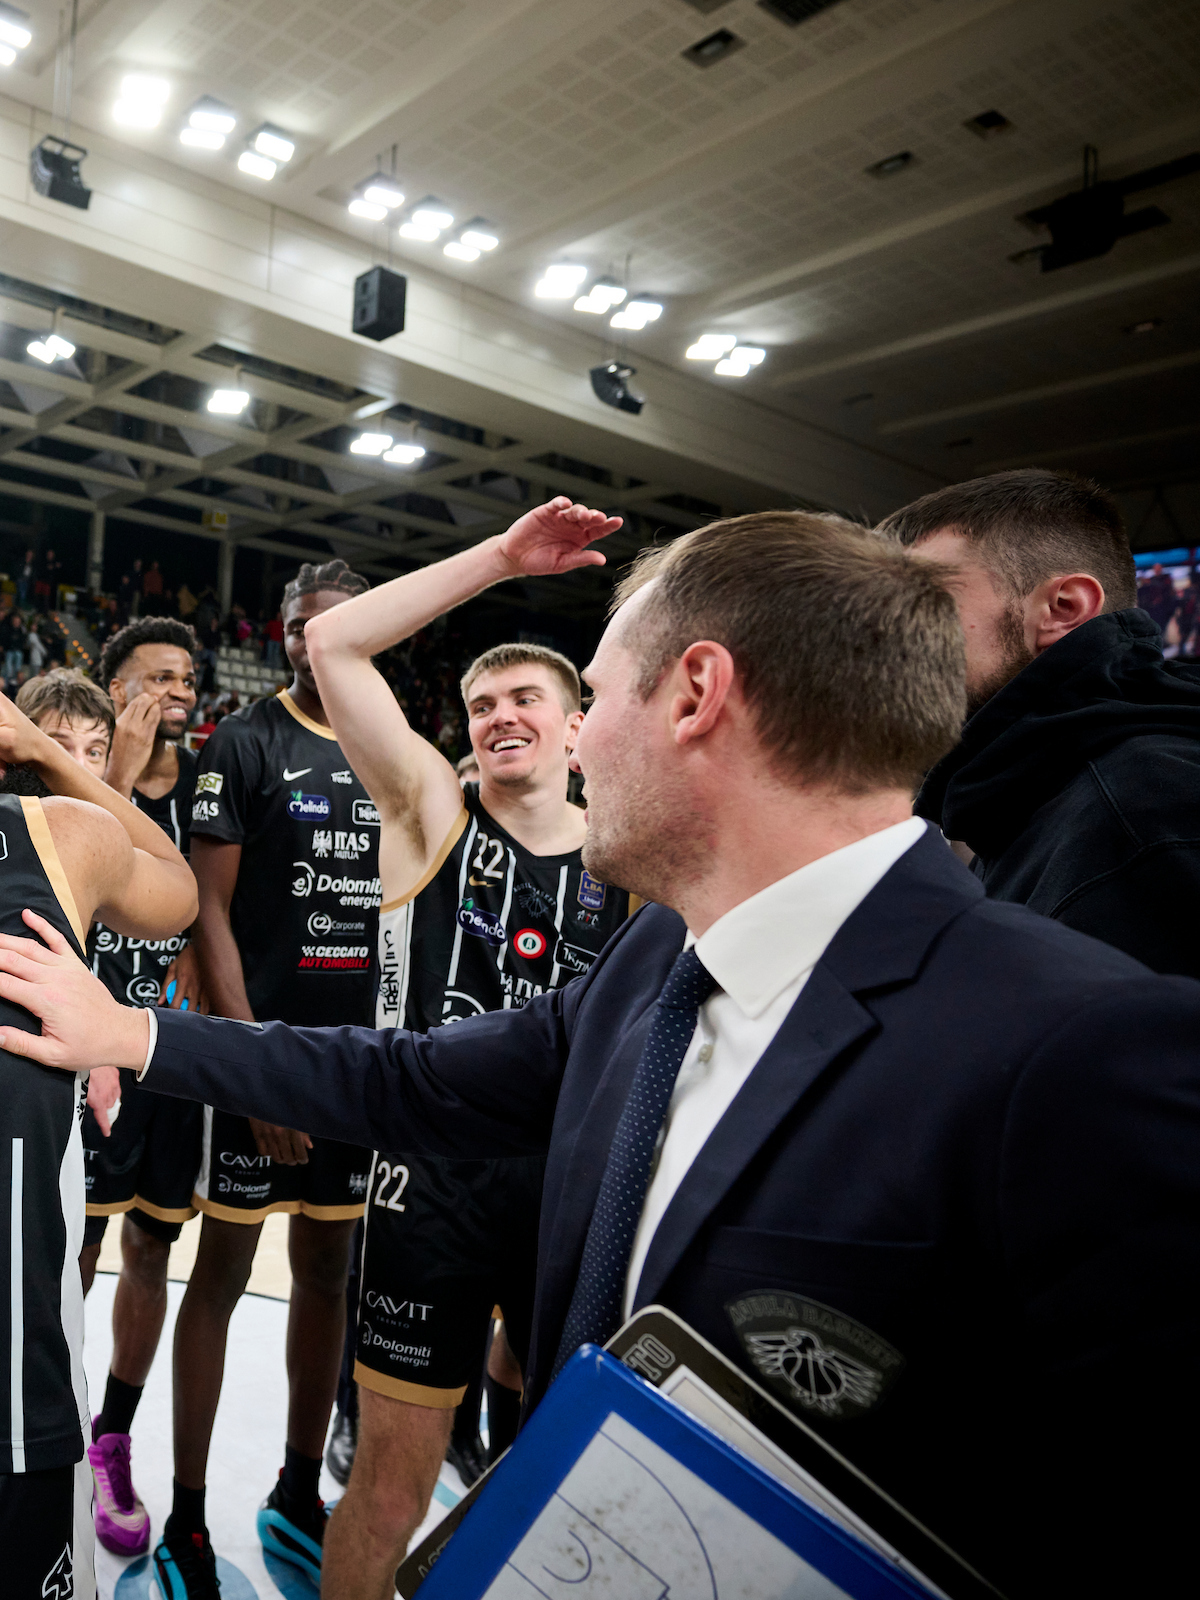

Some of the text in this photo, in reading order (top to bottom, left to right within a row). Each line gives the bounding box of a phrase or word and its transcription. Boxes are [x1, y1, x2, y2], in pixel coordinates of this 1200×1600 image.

[289, 800, 329, 814] Melinda
[334, 831, 370, 852] ITAS
[334, 850, 359, 860] MUTUA
[472, 832, 504, 879] 22
[316, 874, 382, 894] Dolomit
[331, 920, 365, 930] Corporate
[315, 946, 369, 958] CECCATO
[298, 957, 370, 969] AUTOMOBILI
[220, 1152, 271, 1168] CAVIT
[374, 1161, 409, 1212] 22
[366, 1290, 434, 1321] CAVIT
[373, 1334, 432, 1358] Dolomiti
[390, 1353, 429, 1367] energia
